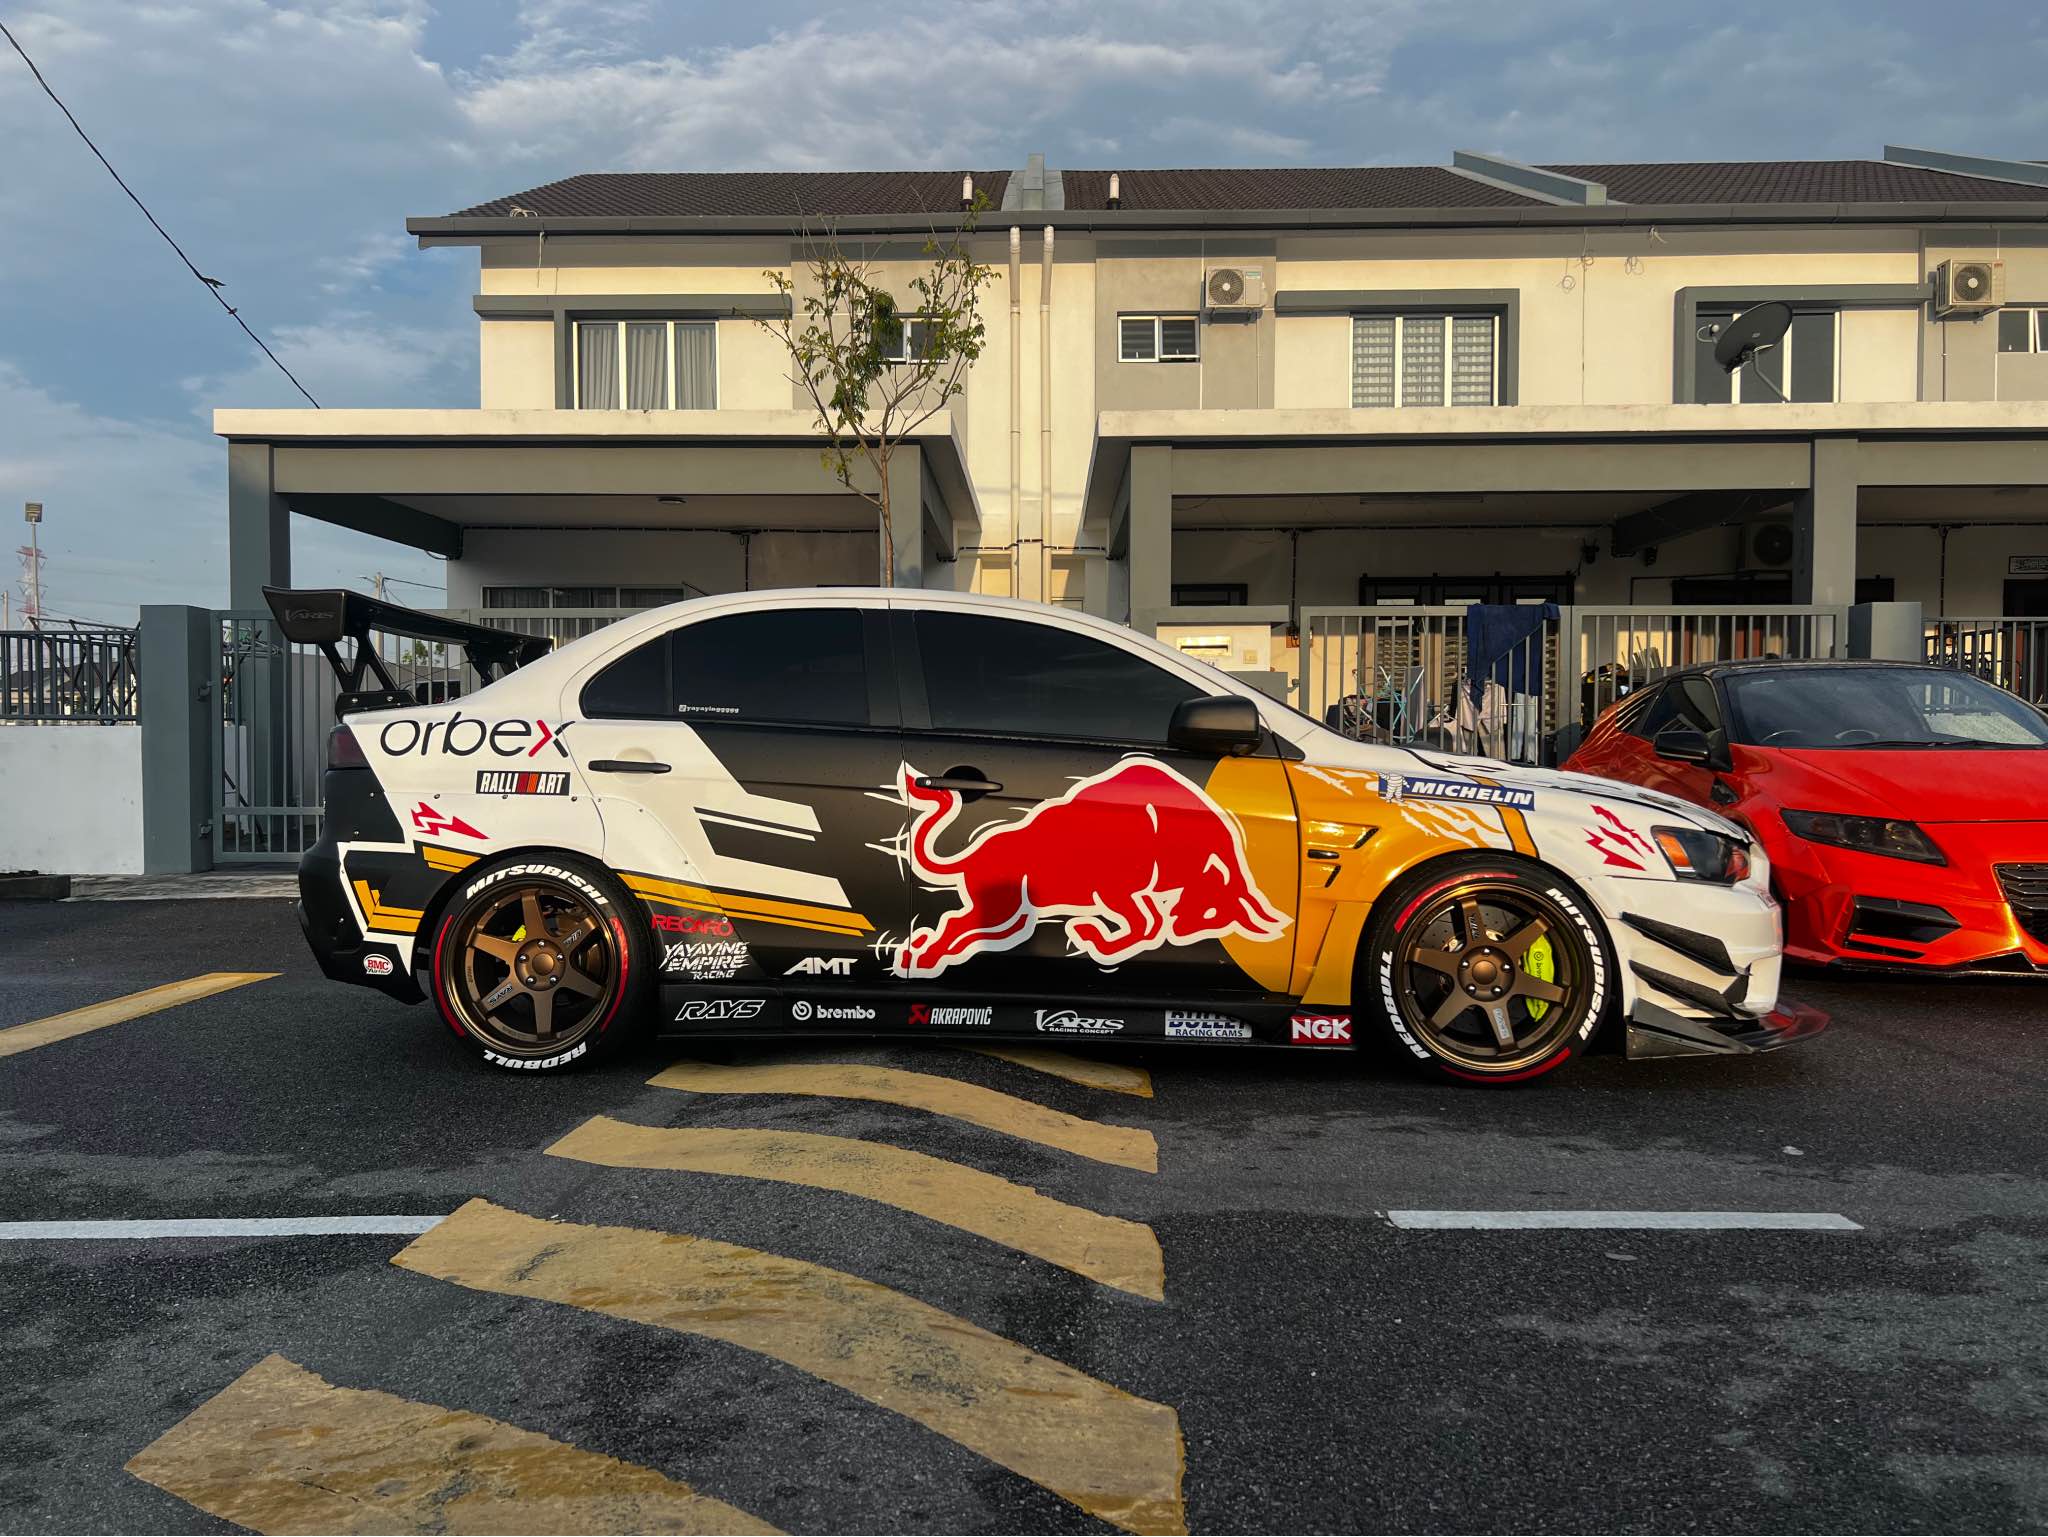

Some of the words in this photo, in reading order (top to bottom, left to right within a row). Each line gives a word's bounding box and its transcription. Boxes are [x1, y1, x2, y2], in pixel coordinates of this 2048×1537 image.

[380, 711, 576, 758] orbex
[1411, 781, 1534, 805] MICHELIN
[466, 864, 610, 905] MITSUBISHI
[652, 913, 735, 937] RECARO
[659, 940, 750, 965] YAYAYING
[664, 954, 750, 972] EMPIRE
[367, 959, 389, 971] BMC
[690, 969, 737, 980] RACING
[782, 957, 859, 976] AMT
[1545, 887, 1605, 1041] MITSUBISHI
[675, 999, 767, 1021] RAYS
[817, 1005, 876, 1019] brembo
[1379, 950, 1432, 1059] REDBULL
[1033, 1009, 1125, 1031] VARIS
[1291, 1018, 1351, 1040] NGK
[1175, 1029, 1213, 1037] RACING
[1215, 1029, 1243, 1037] CAMS
[483, 1041, 588, 1070] REDBULL
